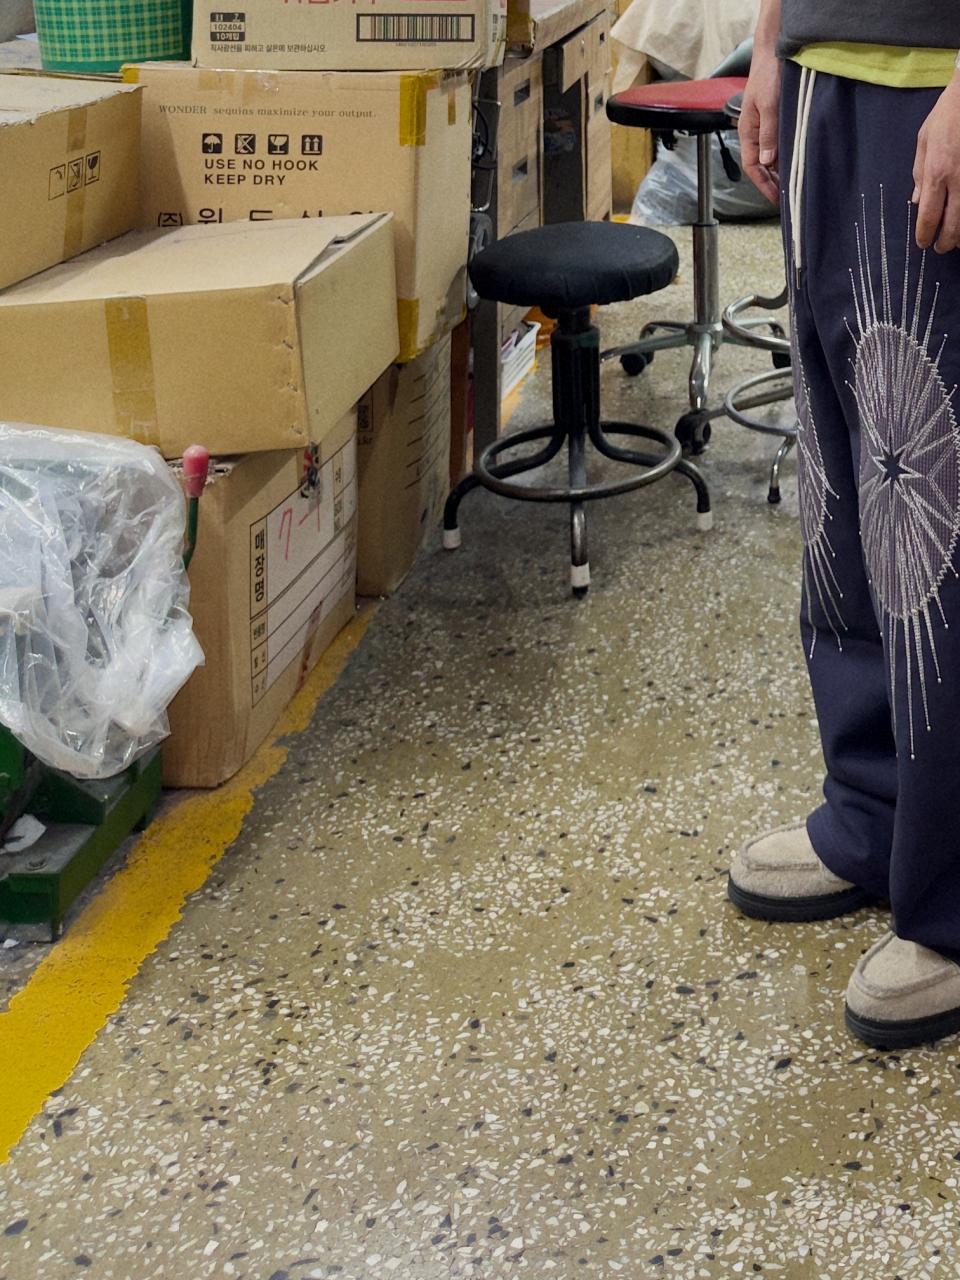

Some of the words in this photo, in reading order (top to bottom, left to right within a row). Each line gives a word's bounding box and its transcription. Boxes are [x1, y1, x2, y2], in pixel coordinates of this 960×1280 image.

[158, 104, 208, 115] WONDER
[212, 107, 255, 117] sequins
[256, 107, 309, 117] maximize
[311, 108, 337, 119] your
[338, 108, 377, 119] output.
[204, 158, 236, 170] USE
[242, 159, 265, 171] NO
[272, 159, 319, 171] HOOK
[204, 173, 247, 185] KEEP
[253, 174, 286, 186] DRY
